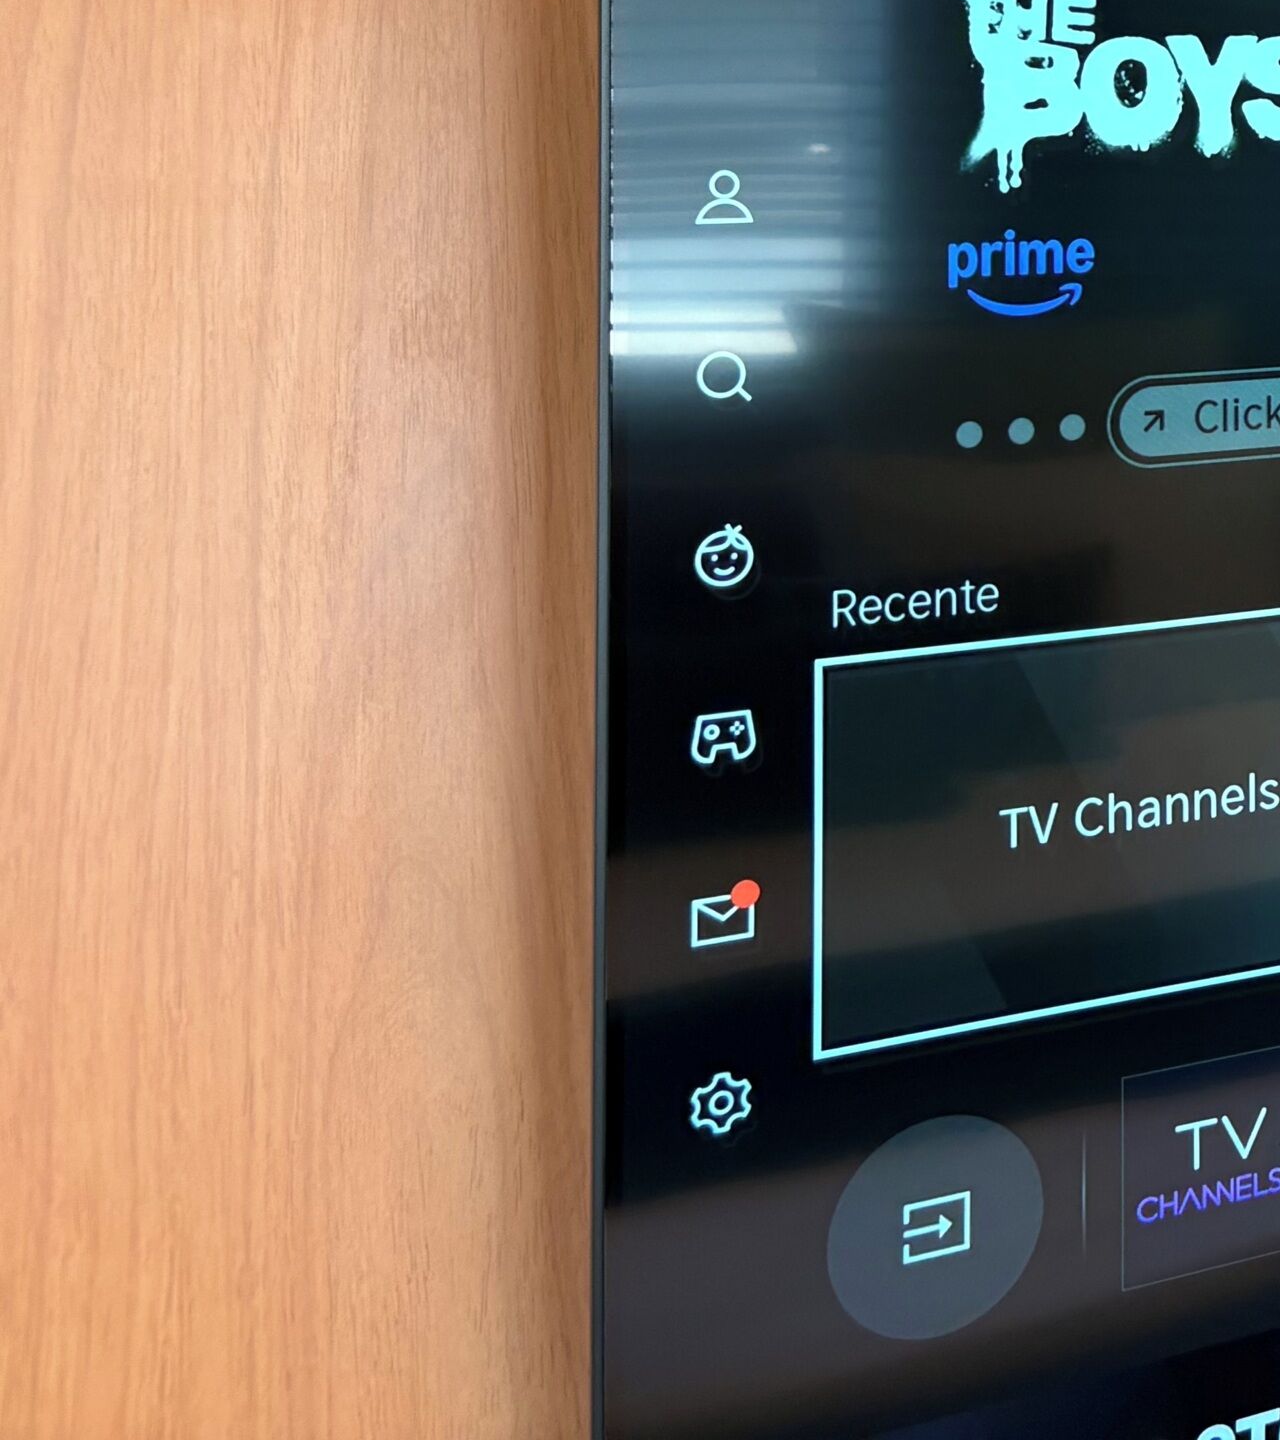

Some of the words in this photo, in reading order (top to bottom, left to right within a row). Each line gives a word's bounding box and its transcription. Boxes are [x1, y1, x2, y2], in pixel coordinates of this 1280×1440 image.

[947, 230, 1095, 289] prime
[831, 579, 1000, 629] Recente
[999, 801, 1058, 849] TV
[1074, 772, 1280, 837] Channels
[1175, 1106, 1268, 1171] TV
